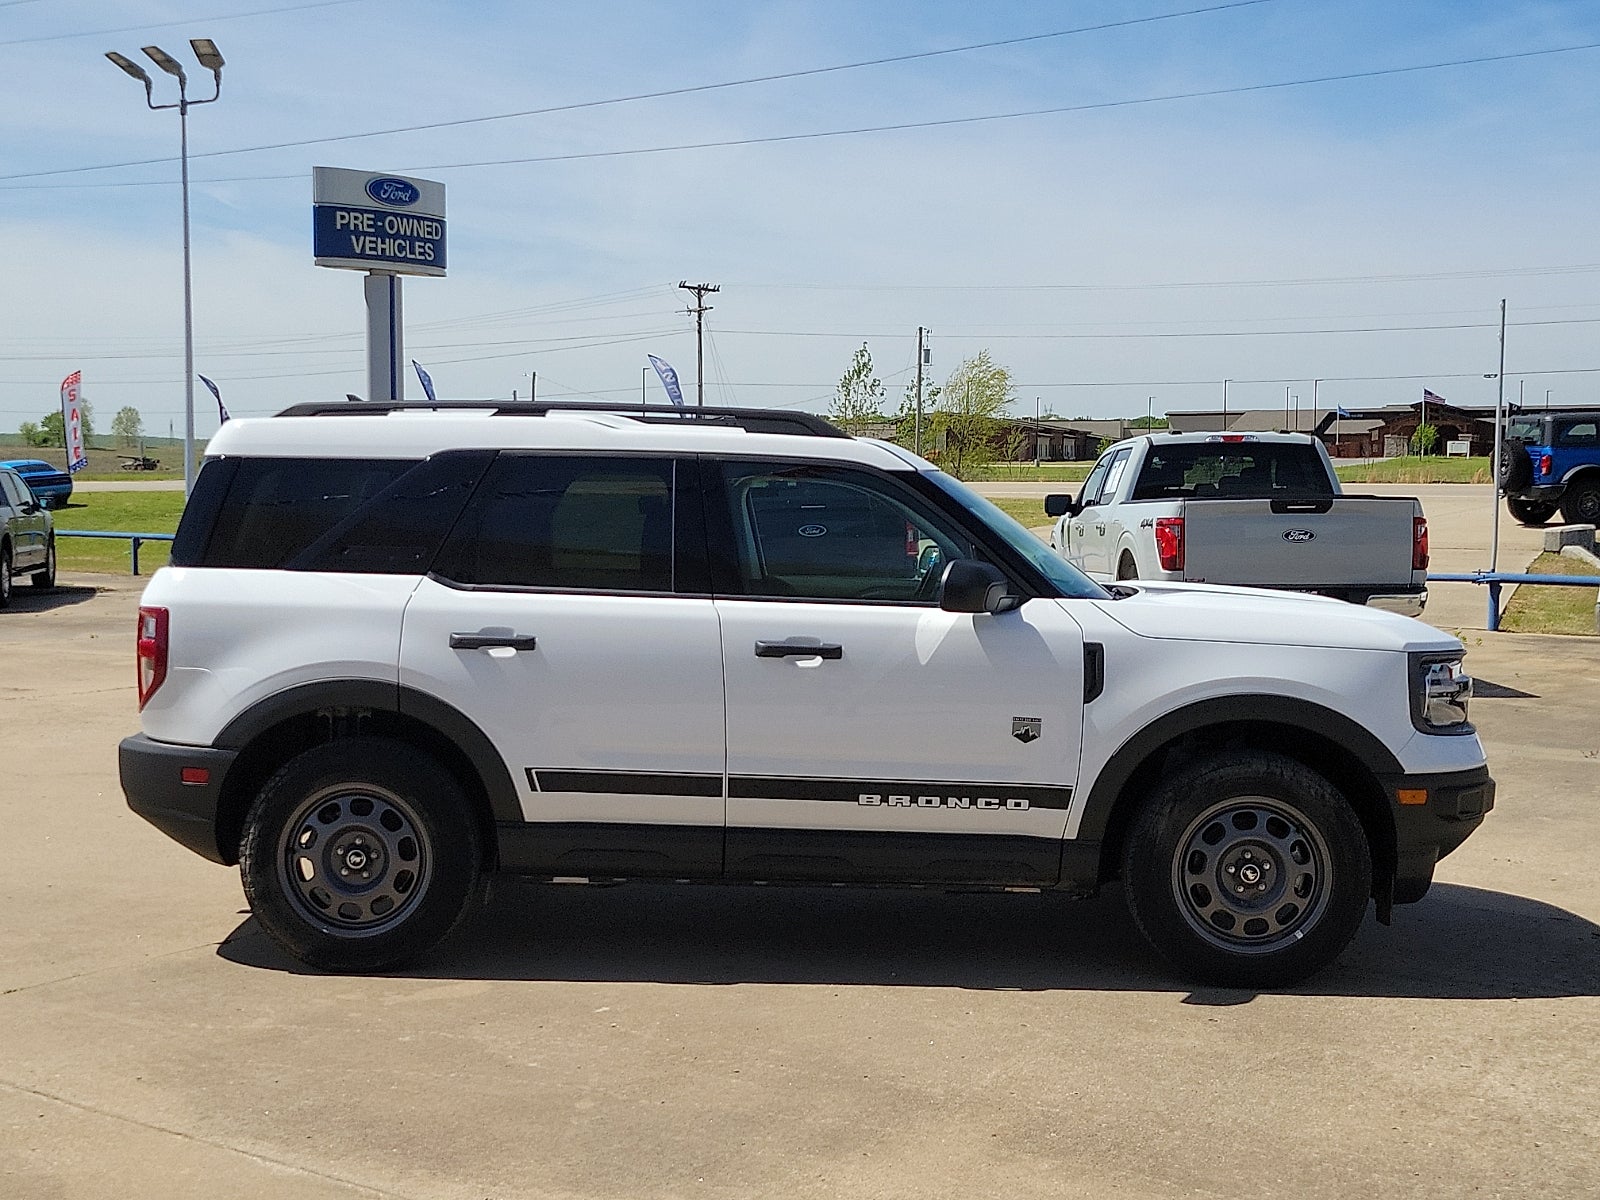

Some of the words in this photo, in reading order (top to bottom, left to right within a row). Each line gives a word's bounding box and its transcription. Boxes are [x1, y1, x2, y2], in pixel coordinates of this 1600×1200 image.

[380, 181, 412, 202] Ford
[335, 211, 442, 240] PRE-OWNED
[351, 235, 435, 261] VEHICLES
[1288, 530, 1311, 540] Ford
[857, 794, 1030, 811] BRONCO
